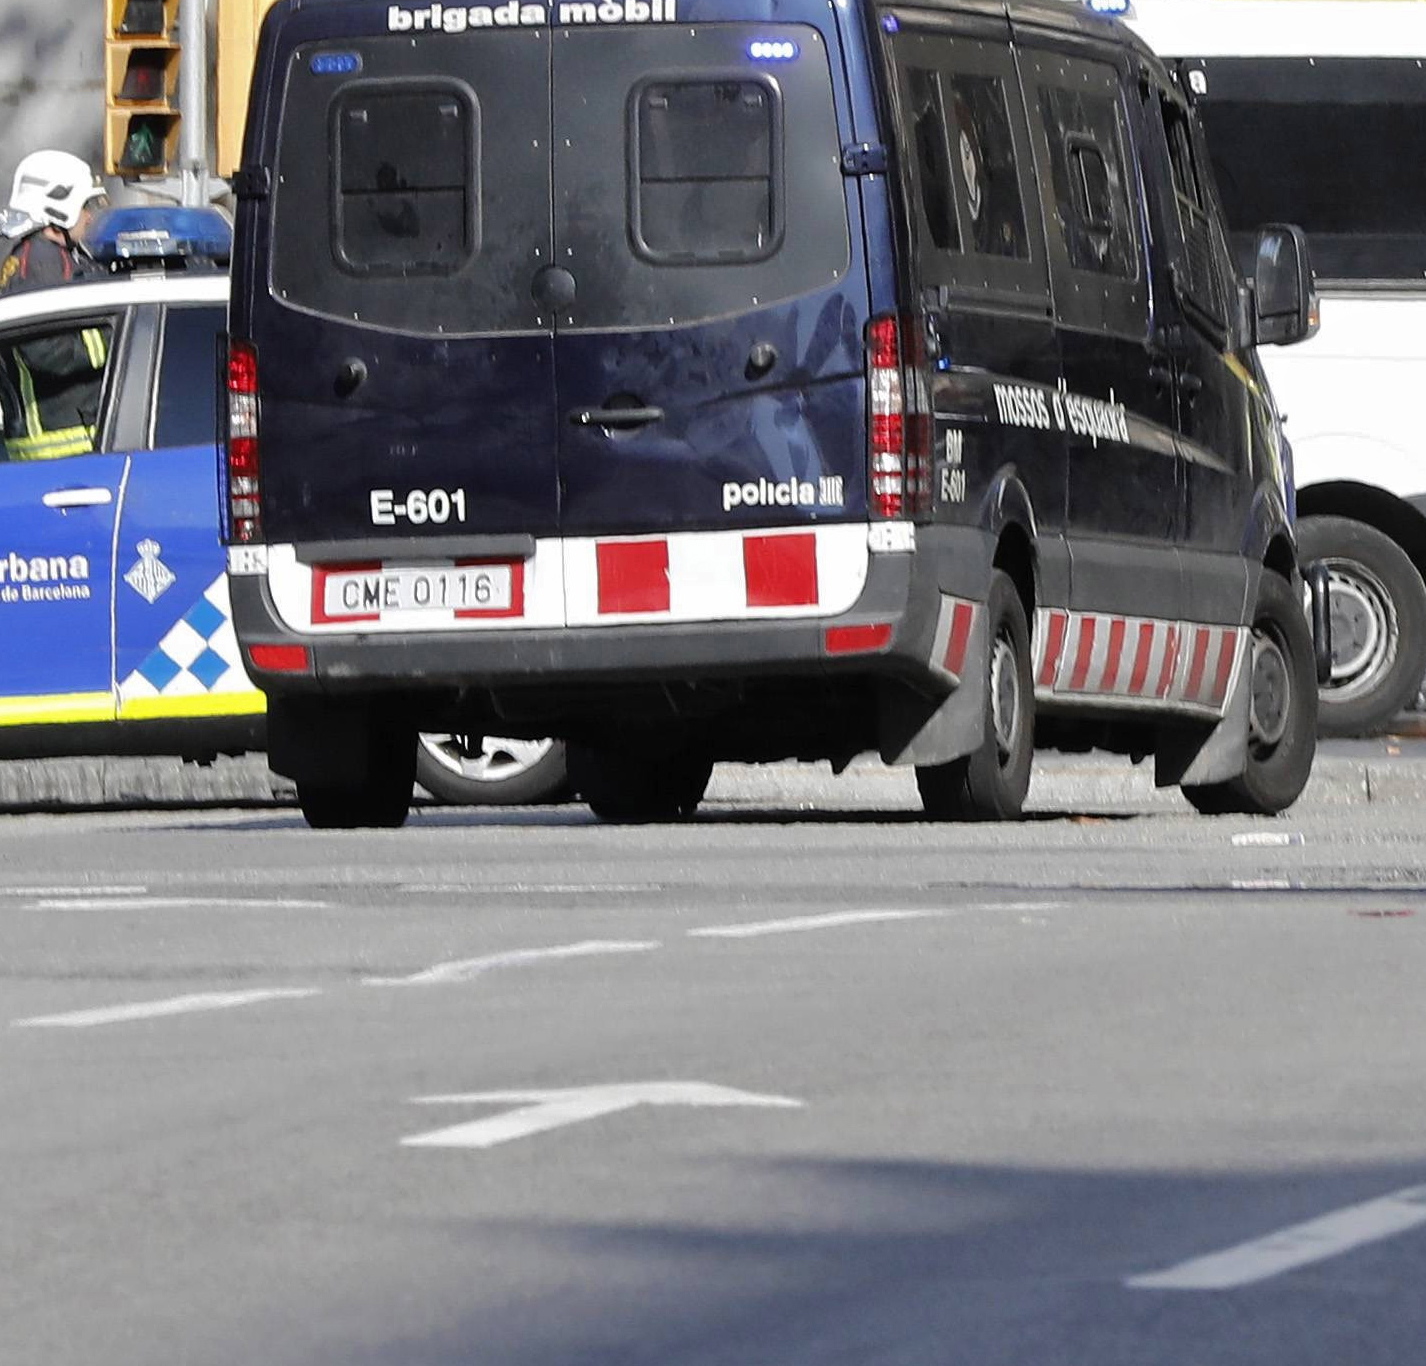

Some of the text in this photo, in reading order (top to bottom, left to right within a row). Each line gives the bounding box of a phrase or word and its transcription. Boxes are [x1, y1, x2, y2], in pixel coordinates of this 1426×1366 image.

[387, 0, 546, 33] brigada
[992, 384, 1051, 430] mossos
[369, 488, 467, 526] E-601
[722, 477, 814, 508] policia
[21, 582, 91, 602] Barcelona
[342, 572, 493, 611] CME 0116
